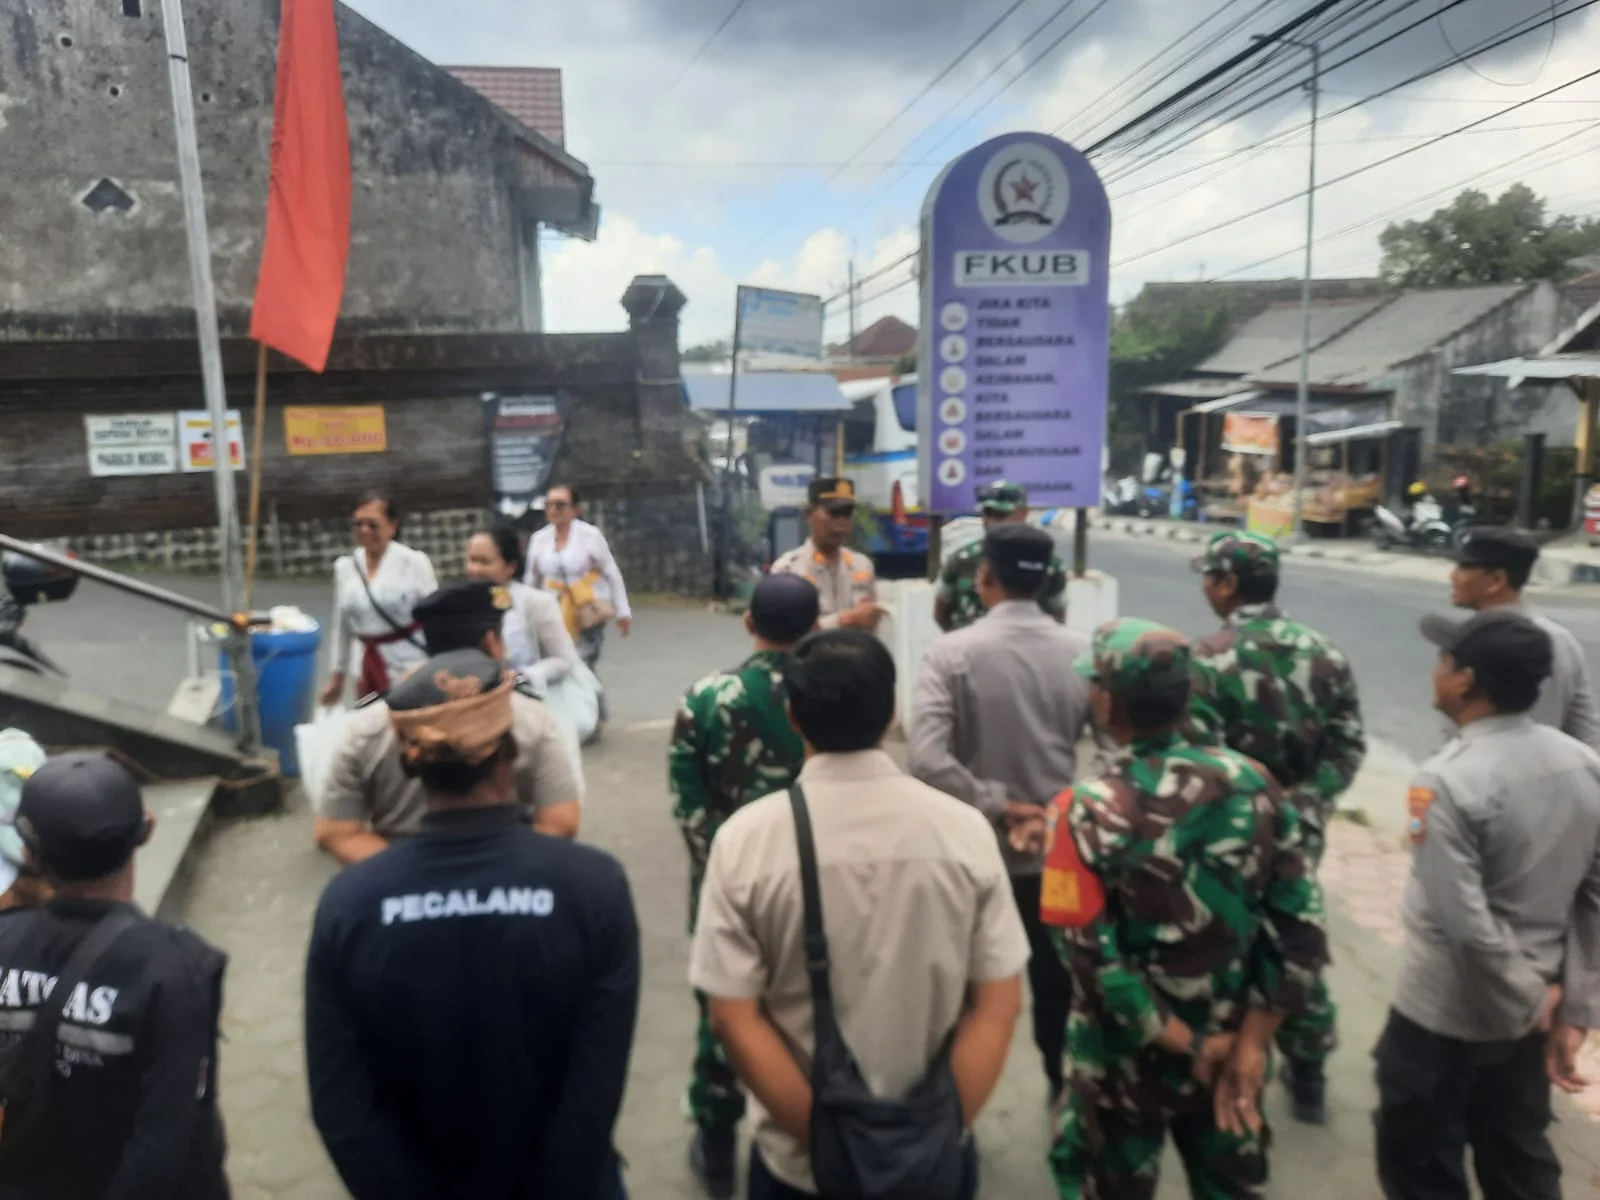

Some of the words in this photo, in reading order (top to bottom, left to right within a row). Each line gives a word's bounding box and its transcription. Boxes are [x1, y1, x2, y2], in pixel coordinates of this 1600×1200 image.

[964, 254, 1077, 275] FKUB
[1016, 296, 1051, 309] KITA
[976, 316, 1021, 328] TIDAK
[381, 886, 555, 926] PECALANG
